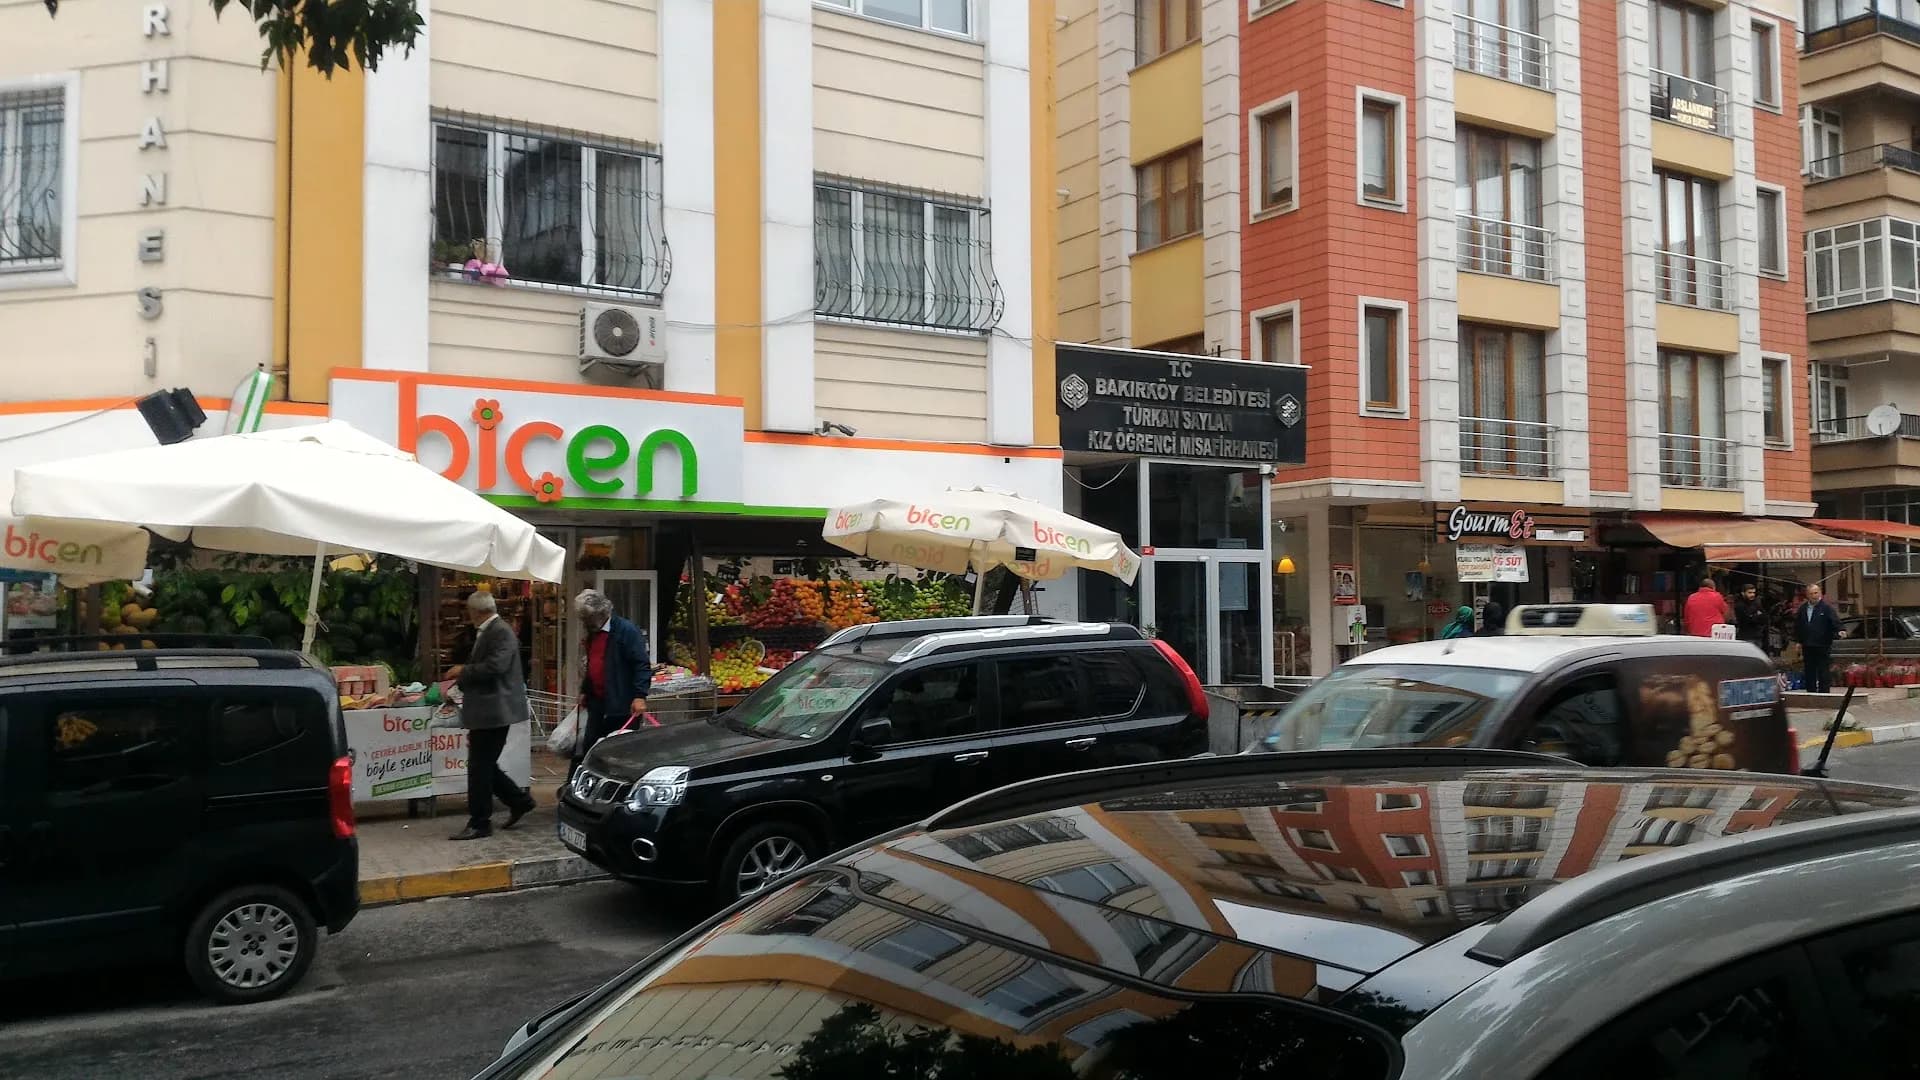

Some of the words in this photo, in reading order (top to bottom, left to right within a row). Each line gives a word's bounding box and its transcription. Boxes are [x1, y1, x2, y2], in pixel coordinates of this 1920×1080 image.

[1095, 377, 1180, 401] BAKIRKÖY
[1183, 384, 1271, 408] BELEDİYESİ
[1122, 402, 1180, 429] TÜRKAN
[1182, 410, 1233, 432] SAYLAN
[1088, 430, 1113, 451] KIZ
[1115, 427, 1177, 454] ÖĞRENCİ
[1180, 434, 1279, 460] MİSAFİRHANESİ
[1448, 505, 1535, 541] GourmEt
[1795, 547, 1826, 560] SHOP
[366, 758, 397, 780] böyle
